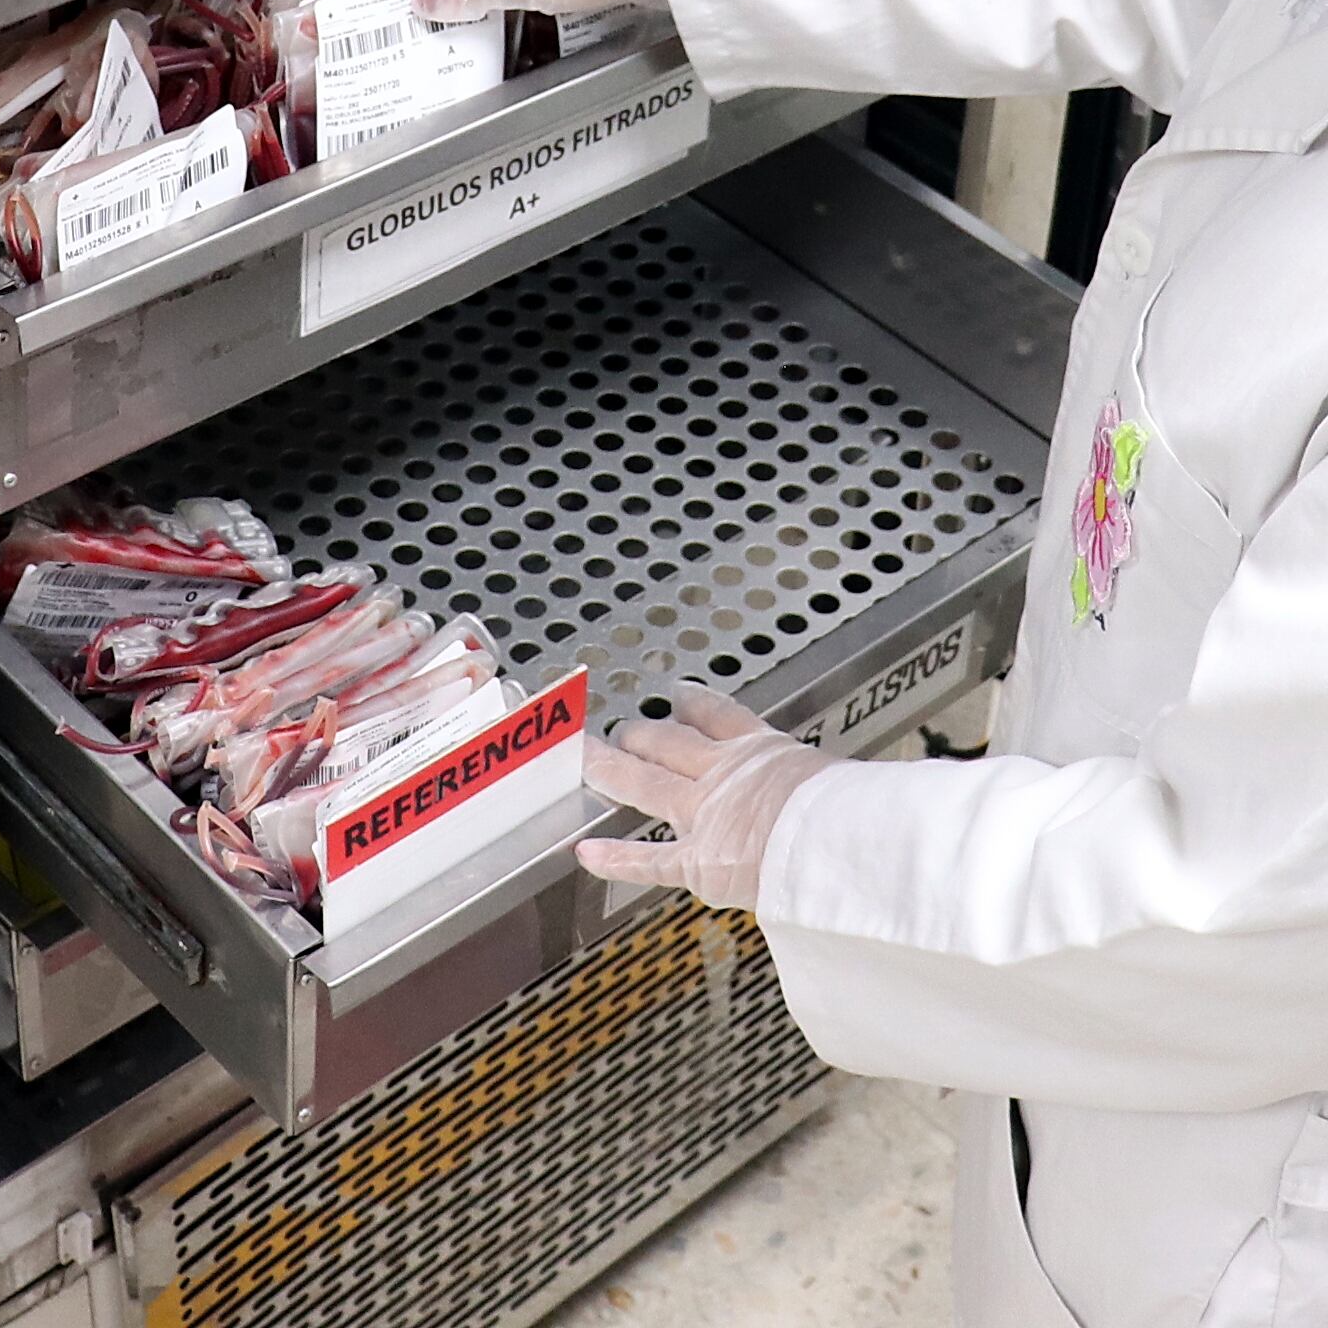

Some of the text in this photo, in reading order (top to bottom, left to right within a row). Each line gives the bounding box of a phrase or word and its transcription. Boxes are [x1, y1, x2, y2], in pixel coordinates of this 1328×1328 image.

[448, 45, 456, 56] A
[437, 59, 475, 75] POSITIVO
[346, 79, 695, 252] GLOBULOS ROJOS FILTRADOS
[194, 200, 202, 211] A
[509, 192, 541, 220] A+
[840, 626, 964, 735] LISTOS
[344, 699, 572, 859] REFERENCÍA
